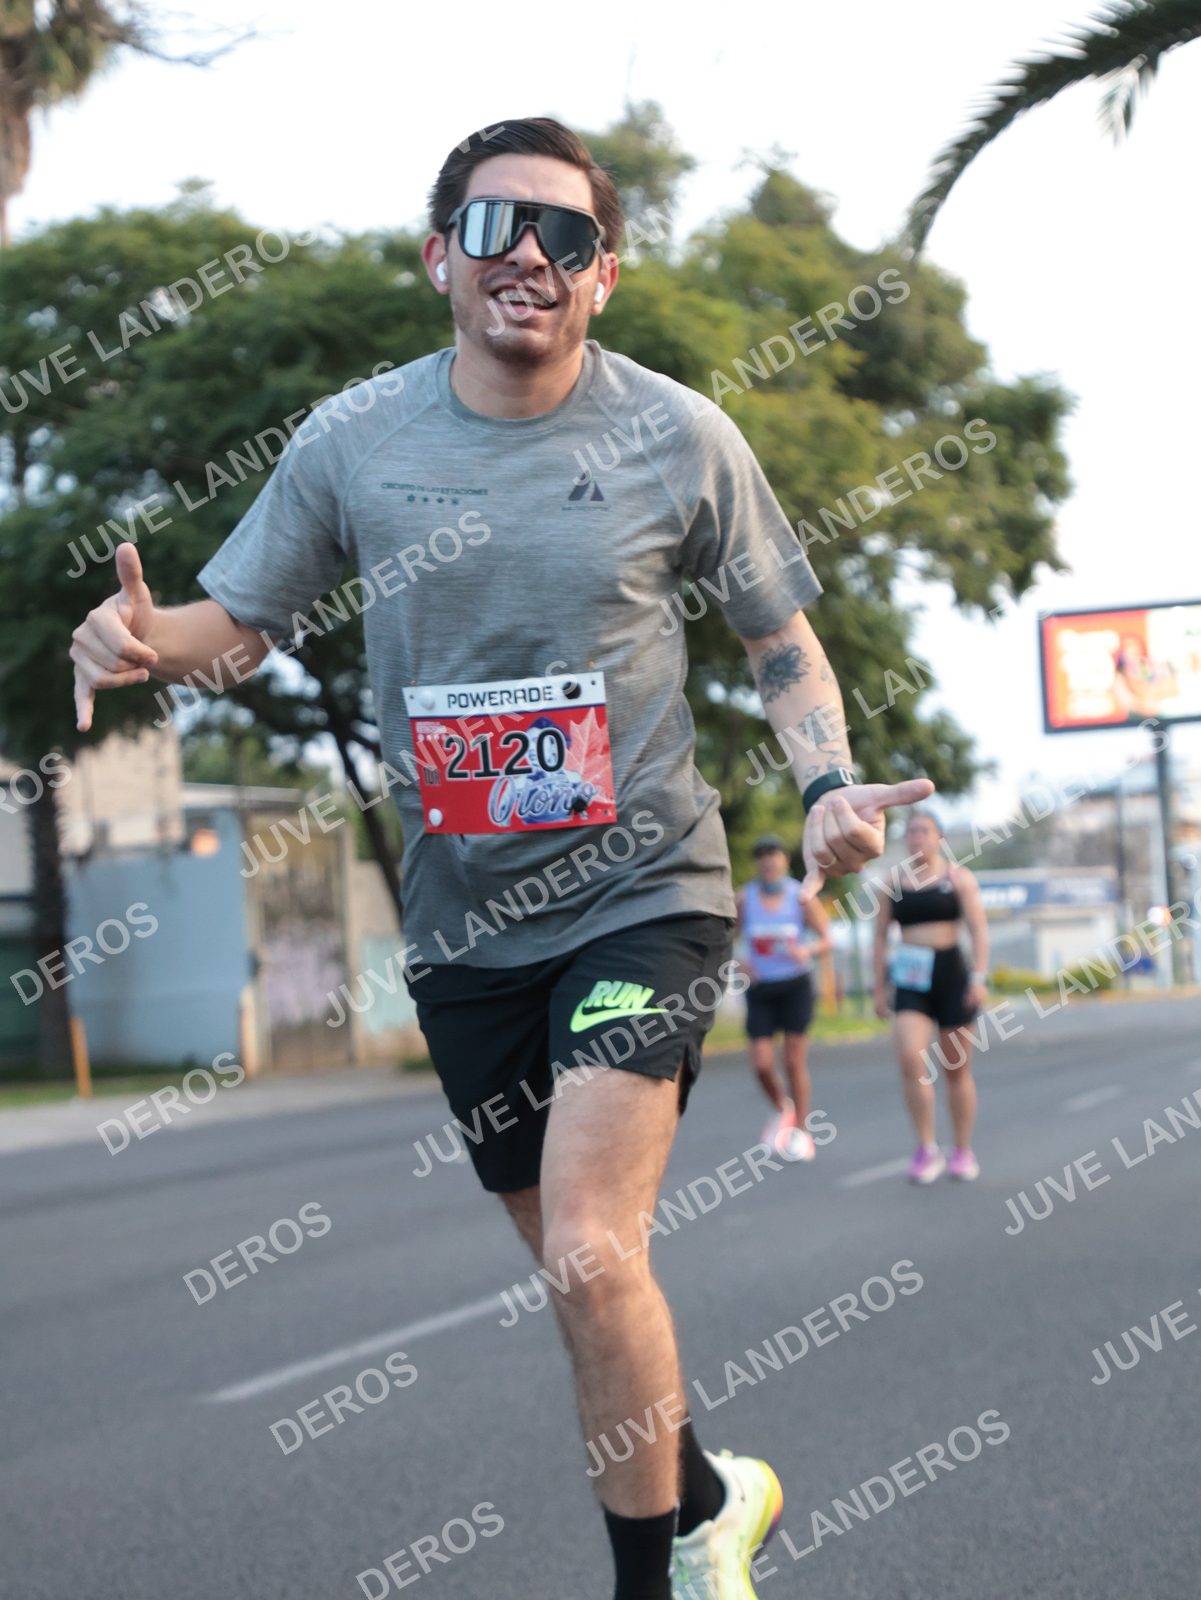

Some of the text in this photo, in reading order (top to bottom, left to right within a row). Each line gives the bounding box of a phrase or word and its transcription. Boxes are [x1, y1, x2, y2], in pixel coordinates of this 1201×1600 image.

[447, 685, 554, 709] POWERADE
[445, 727, 566, 780] 2120
[584, 980, 656, 1010] RUN
